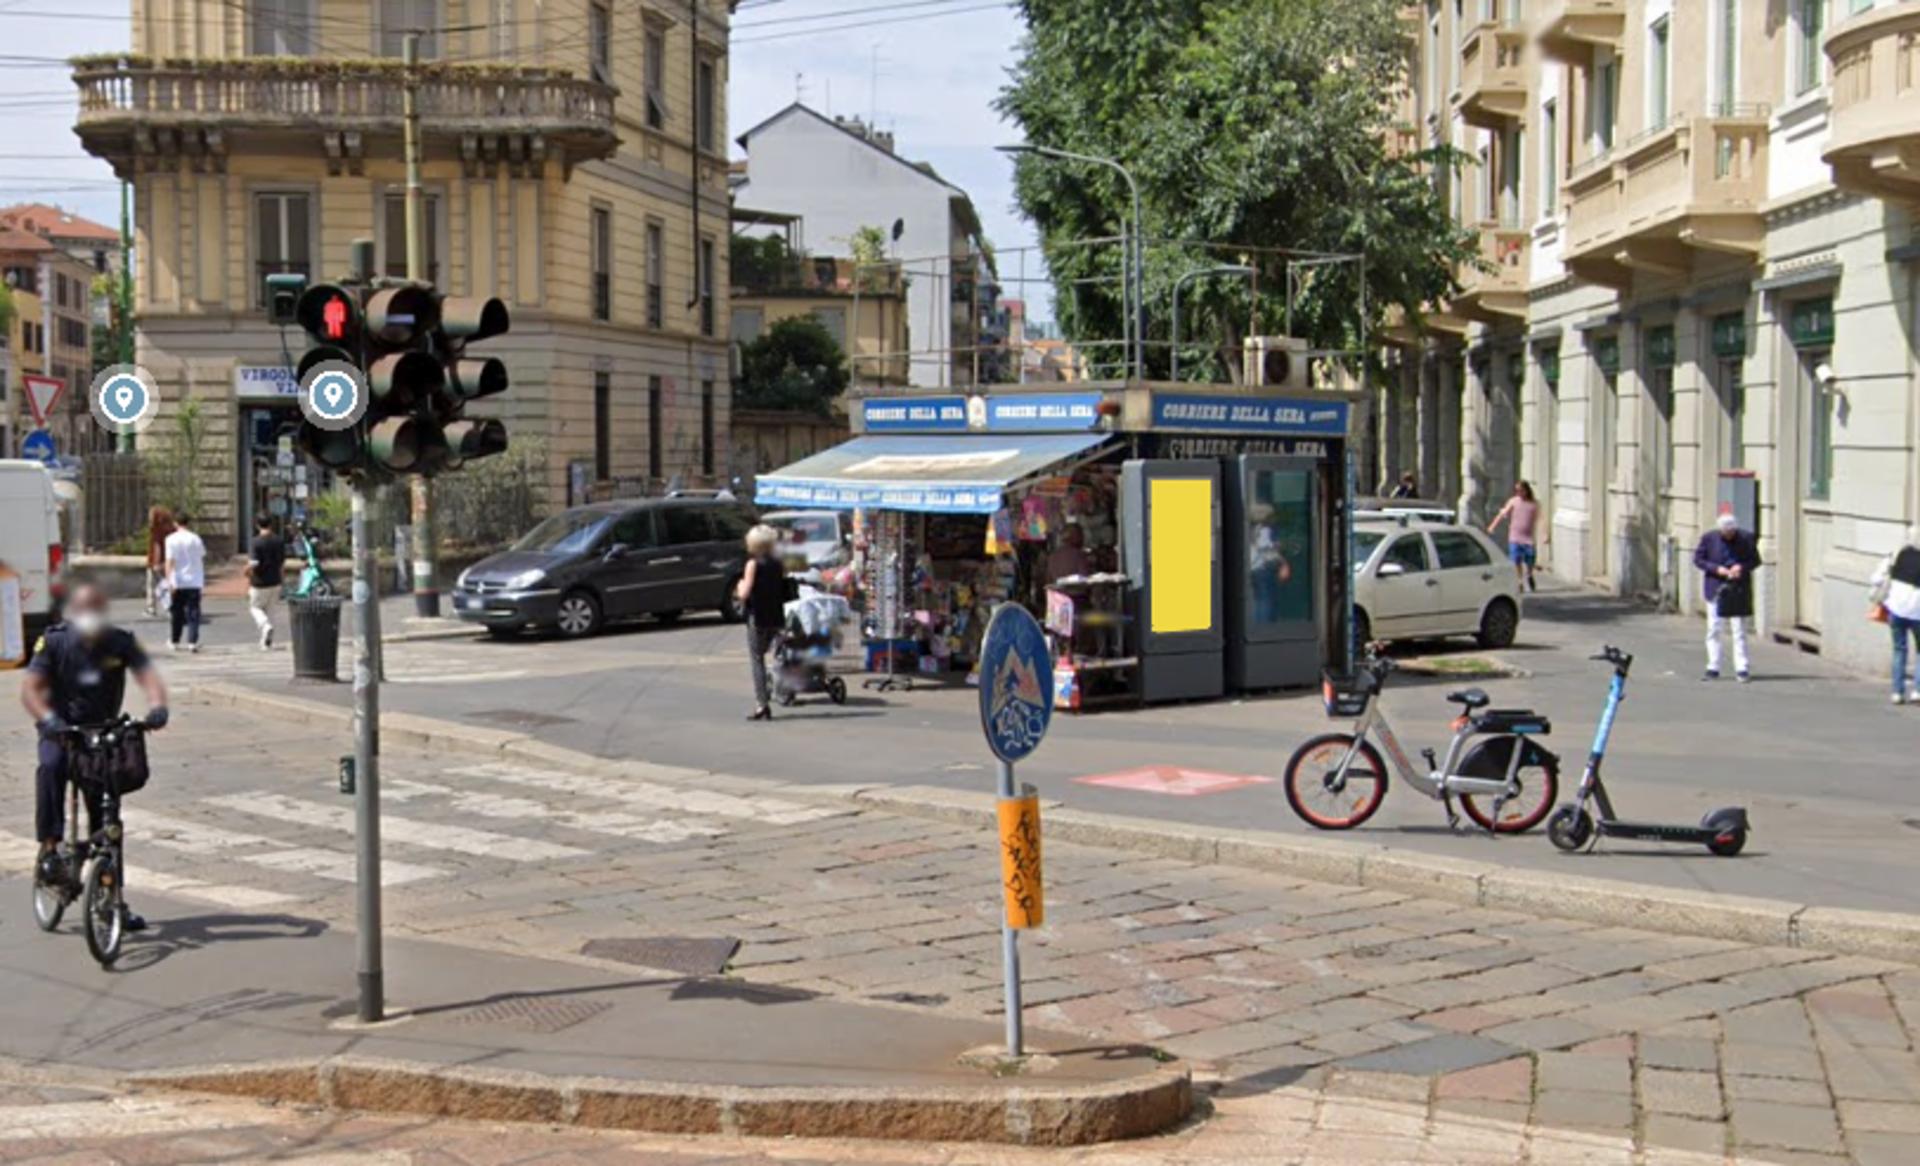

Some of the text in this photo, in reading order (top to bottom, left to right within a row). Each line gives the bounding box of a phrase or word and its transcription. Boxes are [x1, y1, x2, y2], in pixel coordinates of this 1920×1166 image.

[1163, 403, 1228, 421] CORRIERE
[1231, 406, 1270, 422] DELLA
[1274, 407, 1306, 424] SERA
